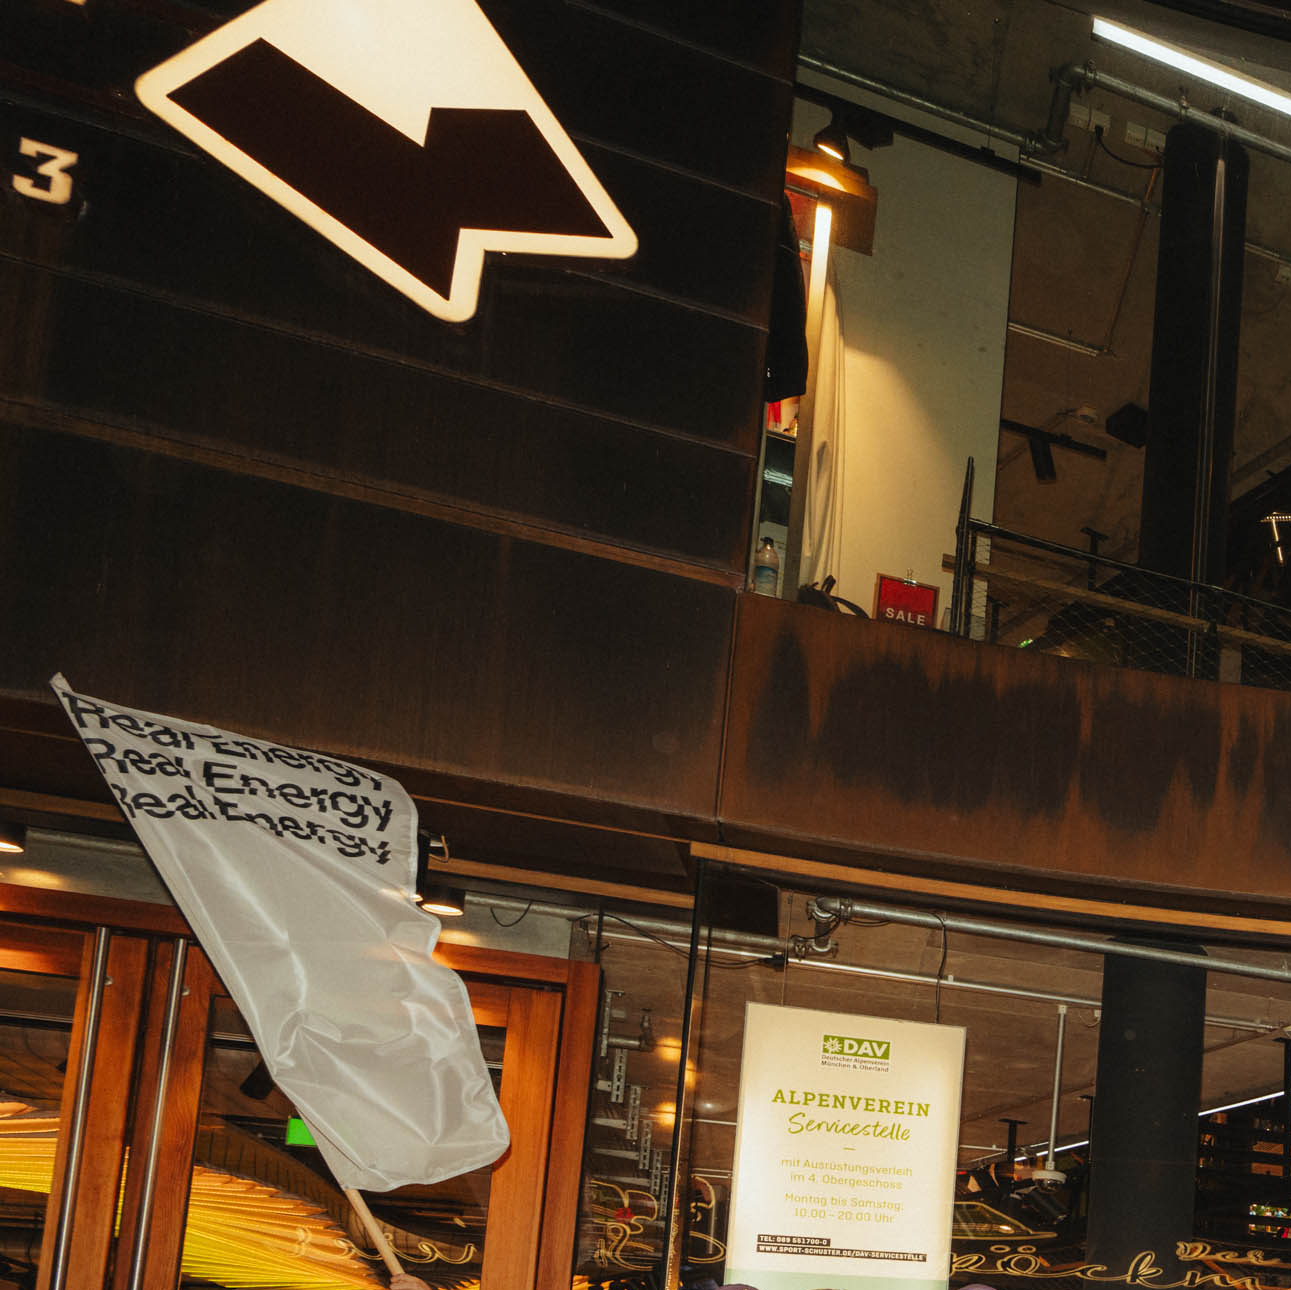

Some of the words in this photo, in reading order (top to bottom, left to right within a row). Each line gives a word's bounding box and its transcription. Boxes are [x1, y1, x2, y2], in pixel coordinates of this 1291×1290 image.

[12, 136, 79, 205] 3
[885, 607, 926, 626] SALE
[63, 691, 195, 750] Real
[192, 732, 382, 791] Energy
[84, 738, 191, 780] Real
[203, 761, 392, 832] Energy
[212, 795, 390, 865] Energy
[843, 1039, 889, 1057] DAV
[771, 1089, 931, 1117] ALPENVEREIN
[787, 1112, 912, 1142] Servicestelle
[781, 1158, 801, 1168] mit
[803, 1158, 913, 1177] Ausrüstungsverleih
[790, 1173, 805, 1182] im
[807, 1174, 819, 1183] 4.
[822, 1175, 903, 1190] Obergeschoss
[784, 1193, 828, 1207] Montag
[830, 1196, 847, 1206] bis
[793, 1207, 826, 1219] 10.00
[837, 1210, 871, 1222] 20.00
[874, 1213, 896, 1224] Uhr
[759, 1235, 775, 1243] TEL:
[758, 1245, 925, 1261] WWW.SPORT-SCHUSTER.DE/DAV-SERVICESTELLE
